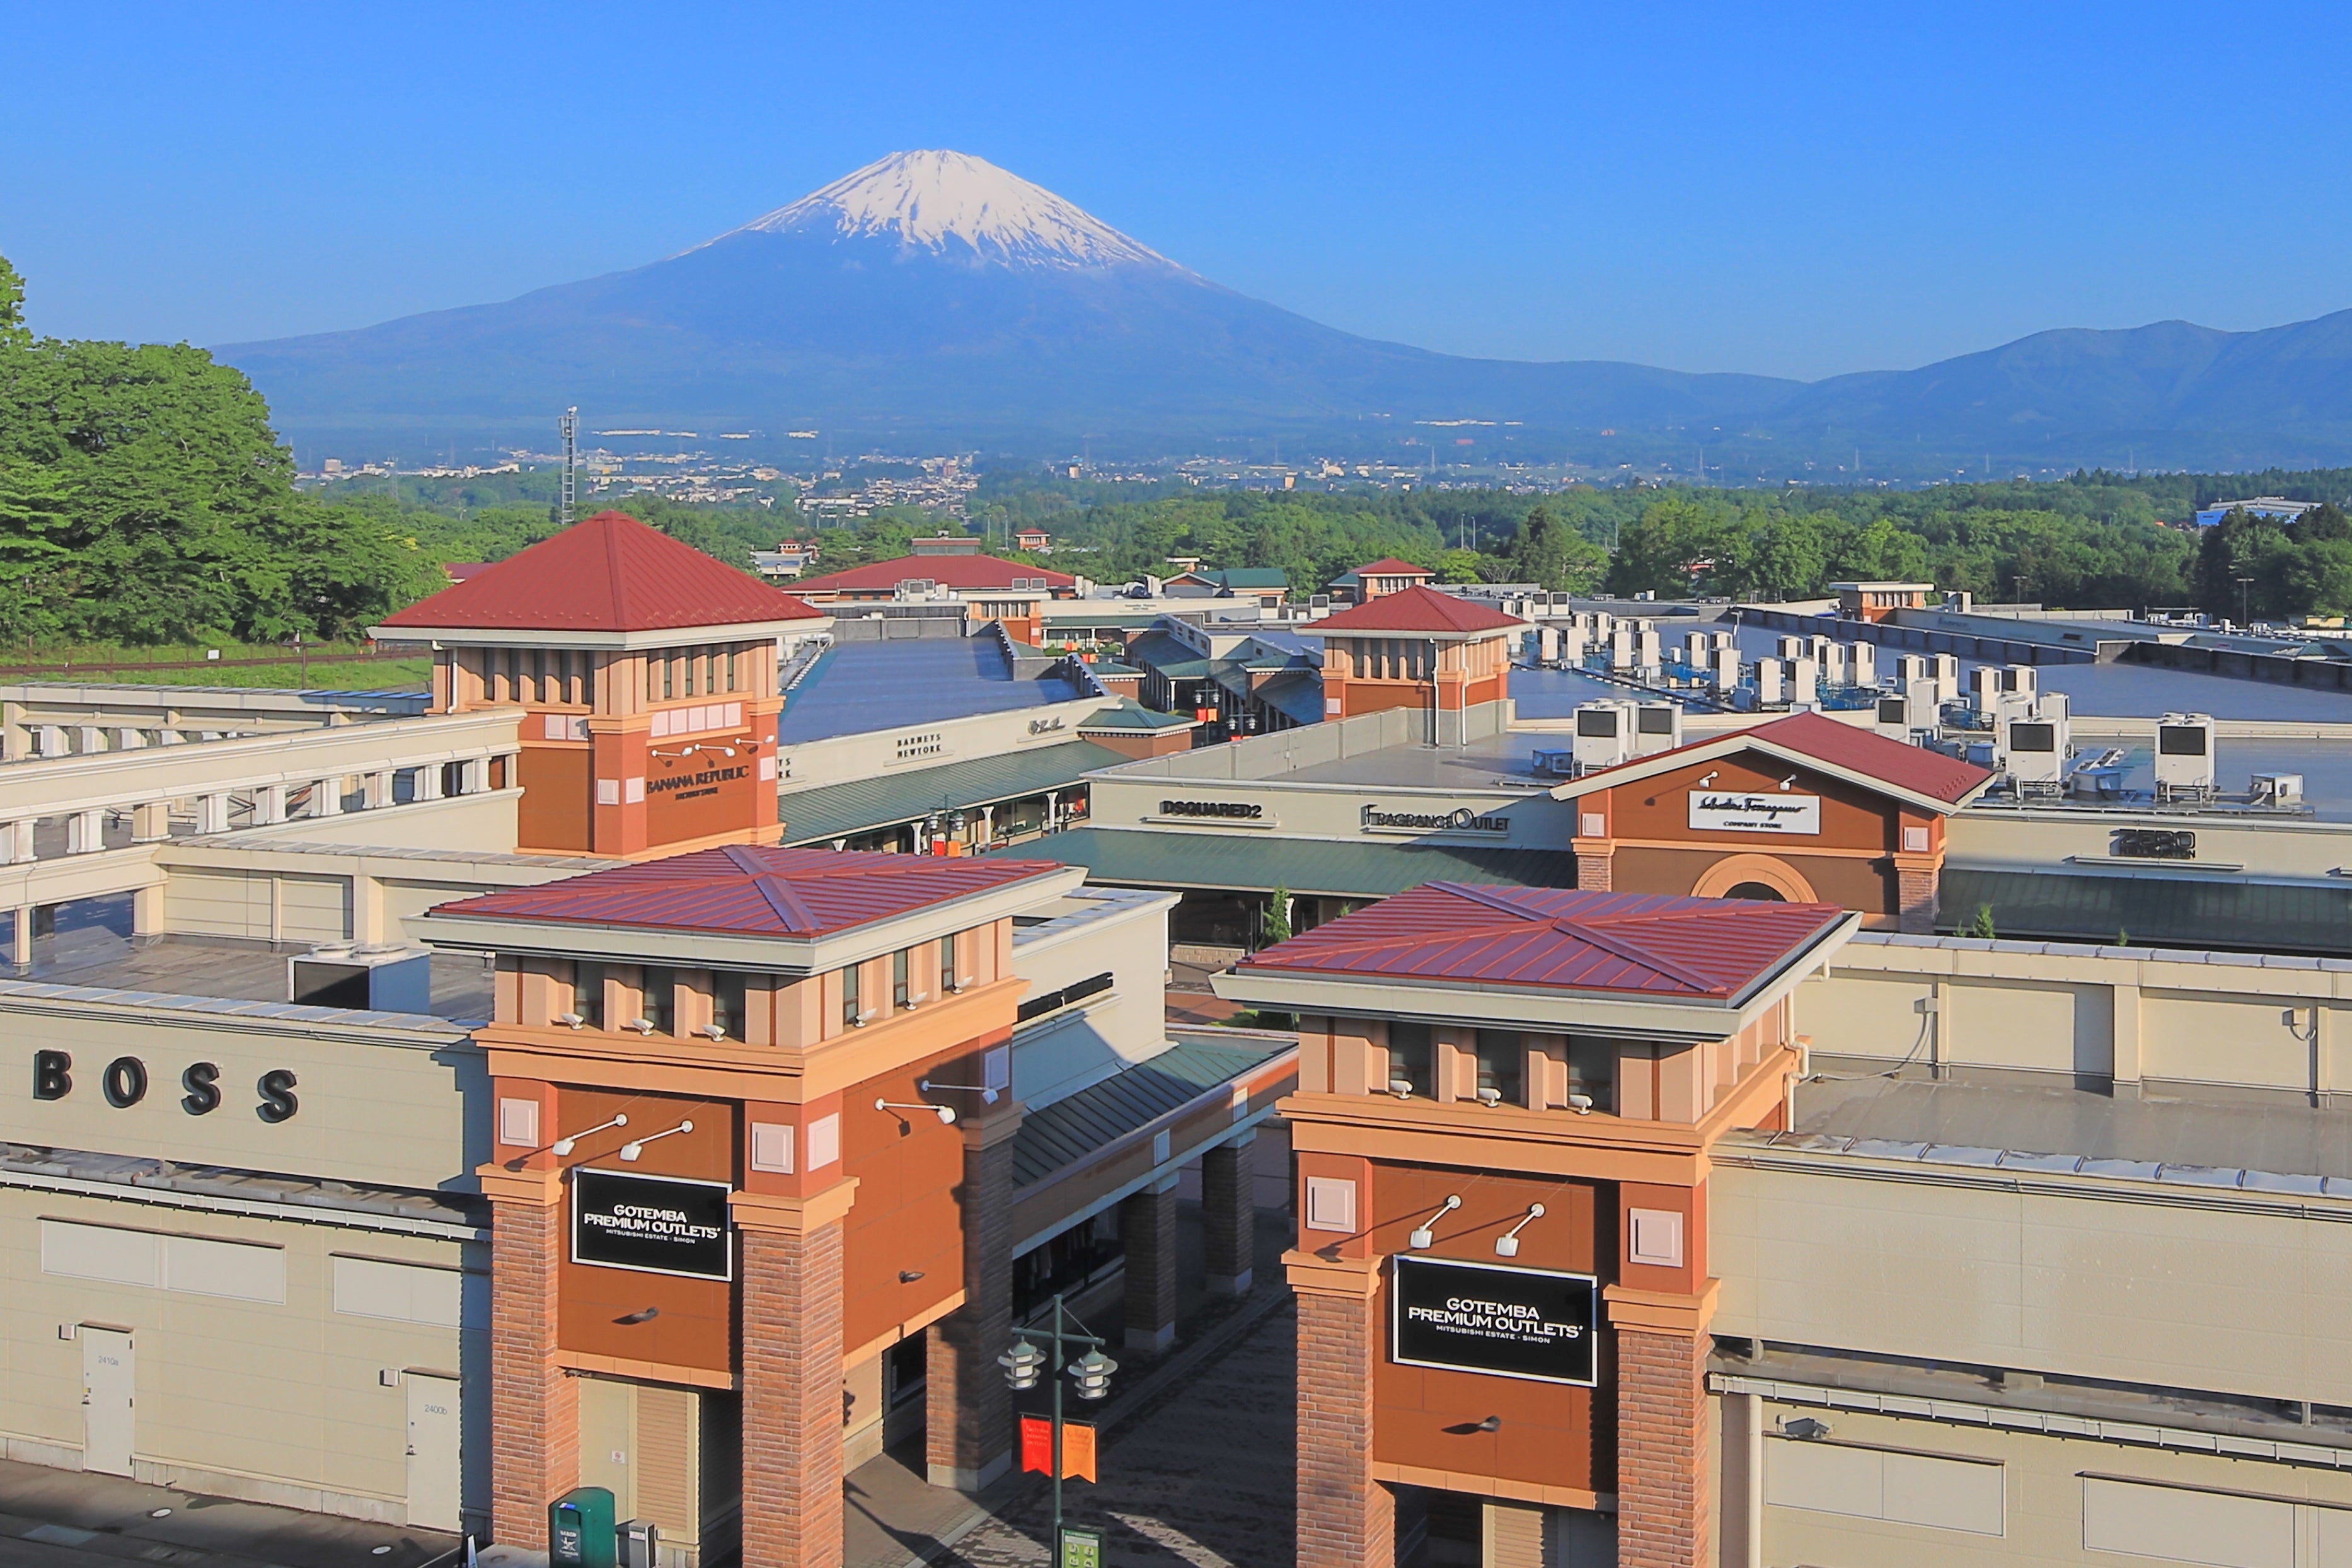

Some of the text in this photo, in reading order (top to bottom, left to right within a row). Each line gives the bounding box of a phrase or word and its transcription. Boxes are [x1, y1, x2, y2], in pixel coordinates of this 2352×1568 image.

[897, 734, 940, 747] BARNEYS
[647, 765, 749, 794] BANANA REPUBLIC
[1160, 800, 1262, 819] DSQUARED2
[1454, 808, 1511, 831] OUTLET
[2118, 829, 2195, 849] ZERO
[33, 1050, 299, 1124] BOSS
[584, 1213, 650, 1231] PREMIUM
[613, 1204, 687, 1223] GOTEMBA
[606, 1229, 644, 1238] MITSUBISHI
[1409, 1306, 1492, 1329] PREMIUM
[1446, 1297, 1540, 1320] GOTEMBA
[1436, 1325, 1551, 1344] MITSUBISHI ESTATE SIMON
[424, 1404, 447, 1415] 2400b
